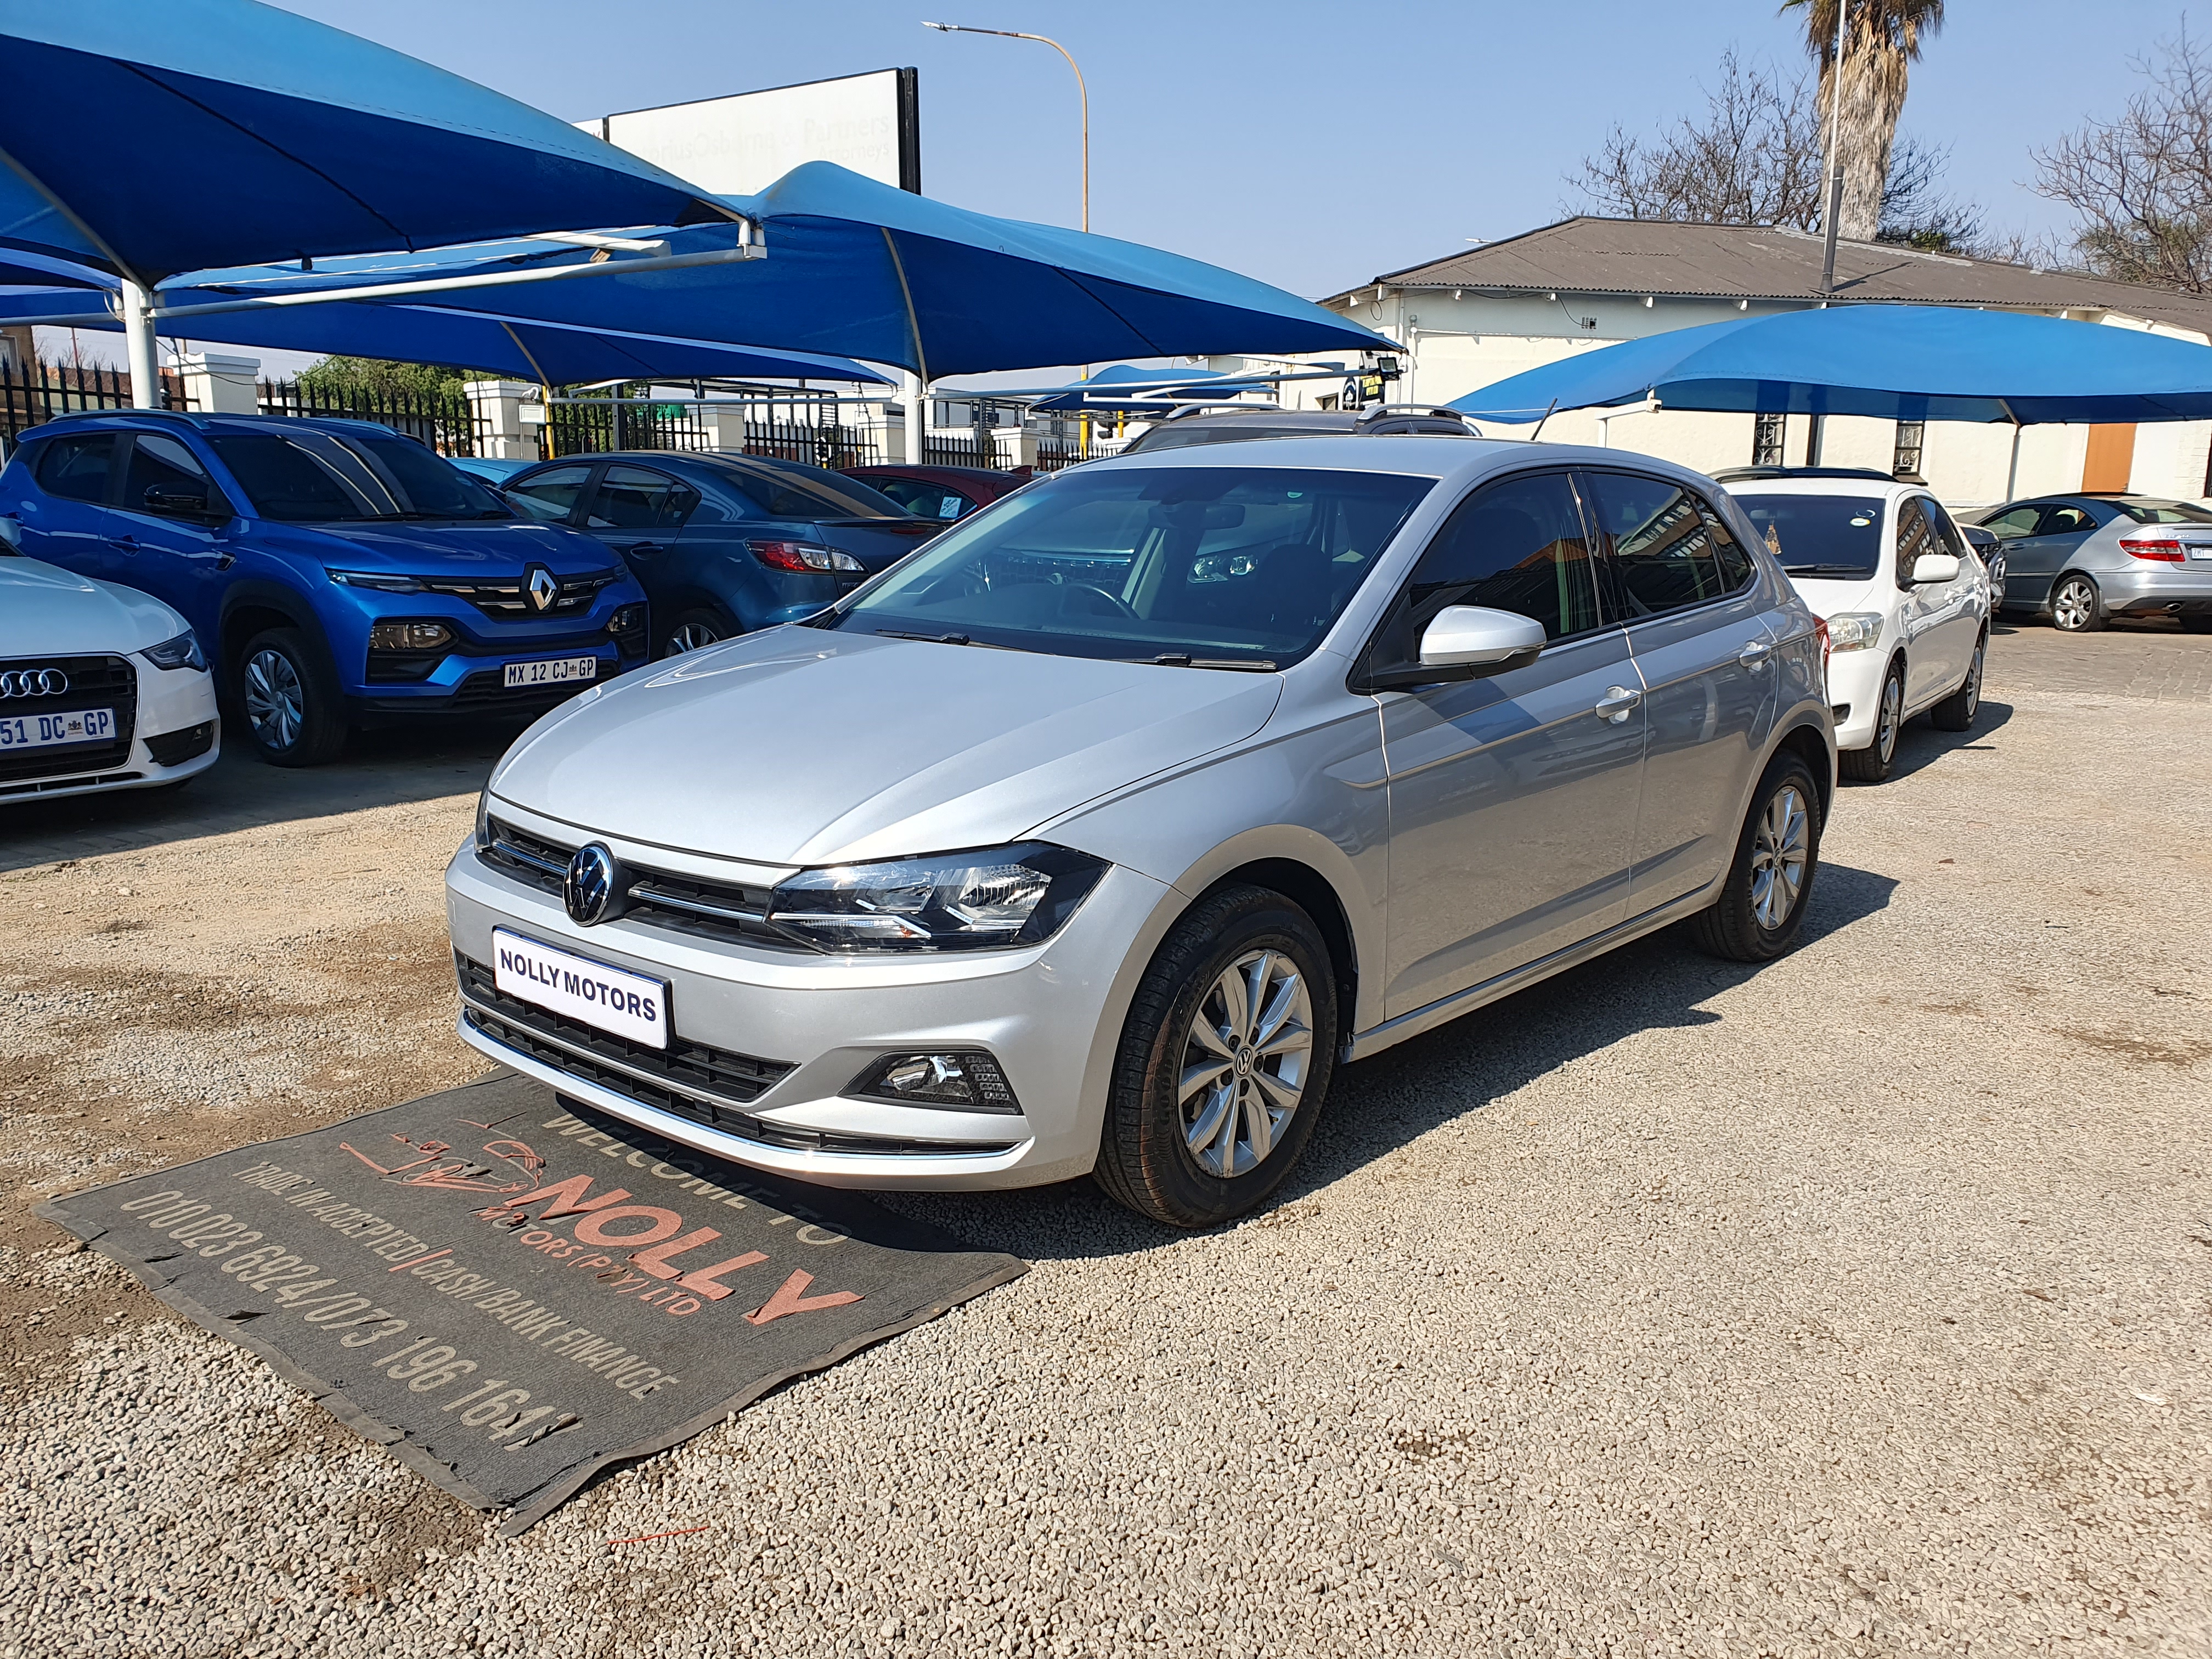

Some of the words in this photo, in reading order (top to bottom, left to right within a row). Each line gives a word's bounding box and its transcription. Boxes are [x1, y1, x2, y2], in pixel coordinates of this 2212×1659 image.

[804, 115, 889, 145] Partners
[509, 665, 525, 684] MX
[531, 664, 546, 681] 12
[552, 662, 568, 679] CJ
[579, 659, 594, 676] GP
[0, 719, 29, 745] 51
[38, 715, 65, 741] DC
[84, 711, 109, 736] GP
[500, 948, 560, 988] NOLLY
[564, 970, 657, 1022] MOTORS
[541, 1113, 780, 1209] WELCOME
[768, 1203, 853, 1245] TO
[232, 1160, 316, 1196] TRADE
[284, 1187, 337, 1208] IN
[541, 1327, 681, 1402] FINANCE
[473, 1206, 584, 1258] MOTORS
[638, 1286, 702, 1316] LTD
[503, 1174, 865, 1325] NOLLY
[372, 1334, 478, 1393] 196
